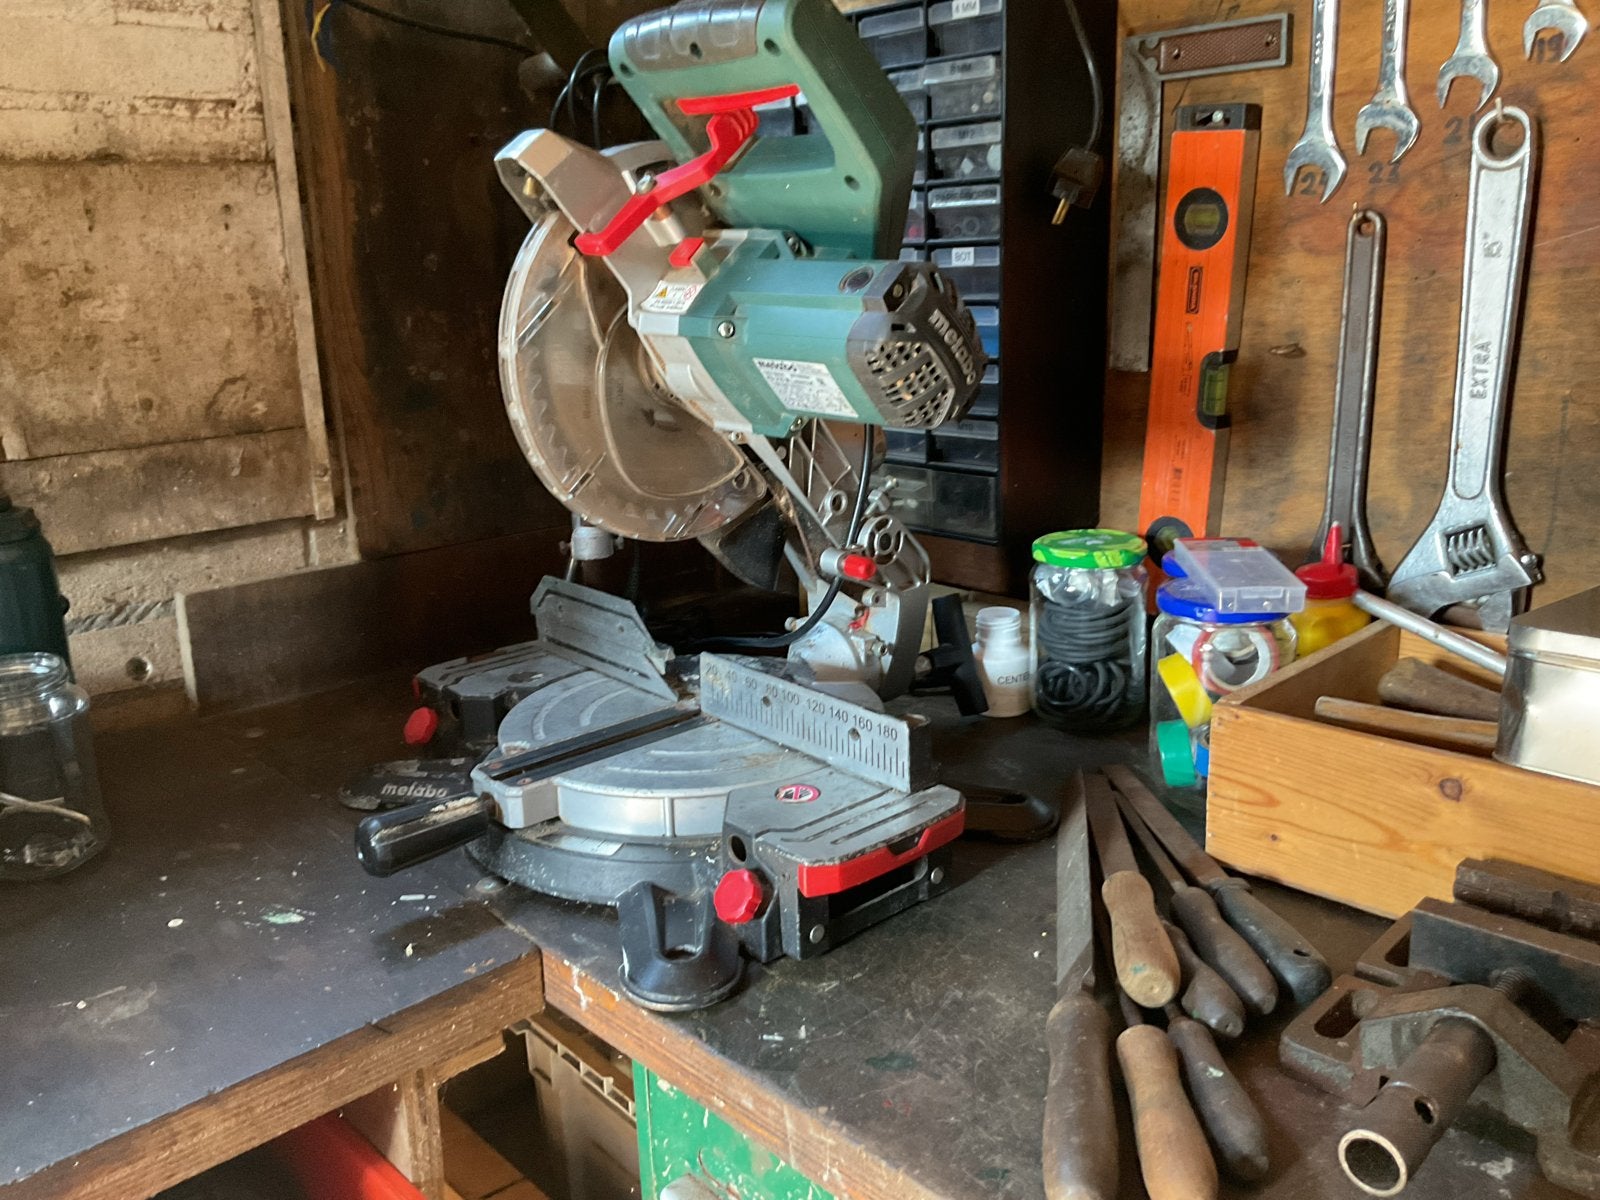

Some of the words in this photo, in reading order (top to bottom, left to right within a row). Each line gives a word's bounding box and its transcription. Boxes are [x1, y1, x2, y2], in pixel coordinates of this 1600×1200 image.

[1537, 35, 1563, 63] 19
[928, 309, 976, 385] metabo
[1469, 340, 1492, 400] EXTRA
[726, 670, 738, 683] 40
[766, 684, 779, 698] 80
[782, 690, 800, 706] 100
[806, 698, 826, 715] 120
[829, 706, 849, 724] 140
[852, 714, 873, 732] 160
[877, 722, 898, 742] 180
[380, 781, 449, 798] metabo
